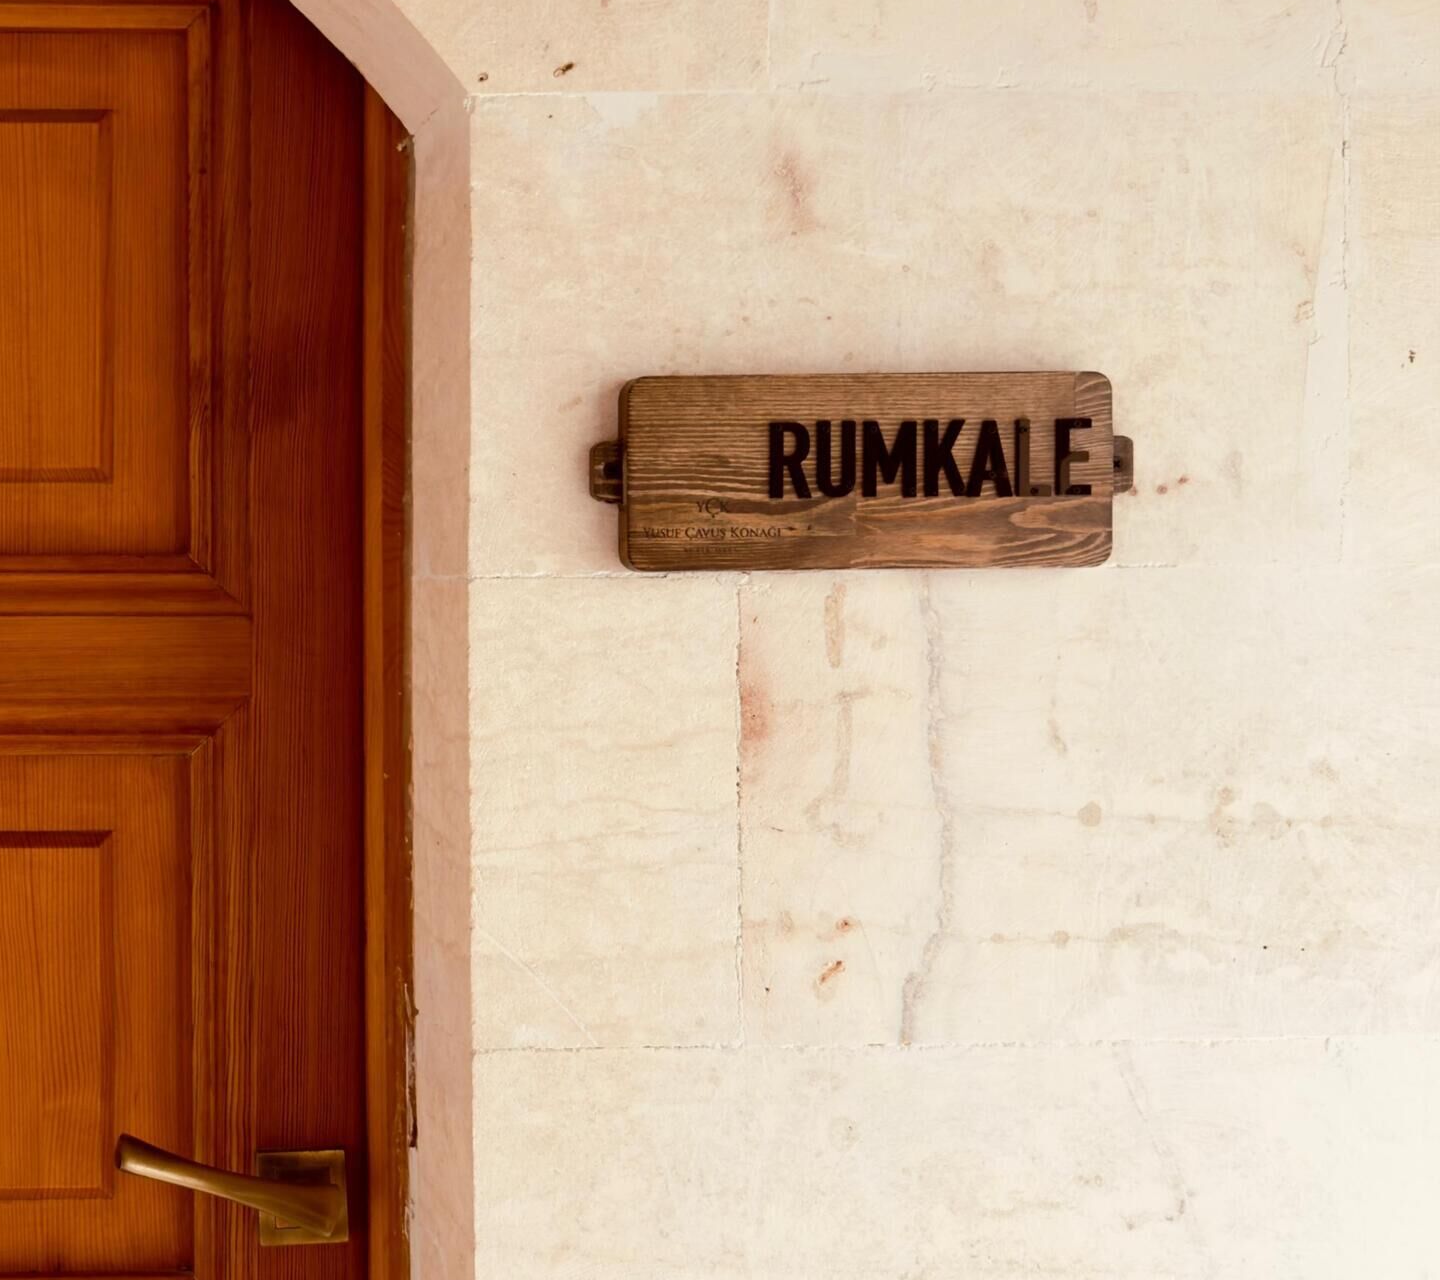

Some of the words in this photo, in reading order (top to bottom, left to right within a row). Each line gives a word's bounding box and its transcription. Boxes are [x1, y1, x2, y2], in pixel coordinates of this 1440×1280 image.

[768, 417, 1093, 499] RUMKALE
[643, 527, 682, 539] YUSUF
[685, 526, 727, 541] ÇAVUŞ
[730, 526, 781, 538] KONAĞI
